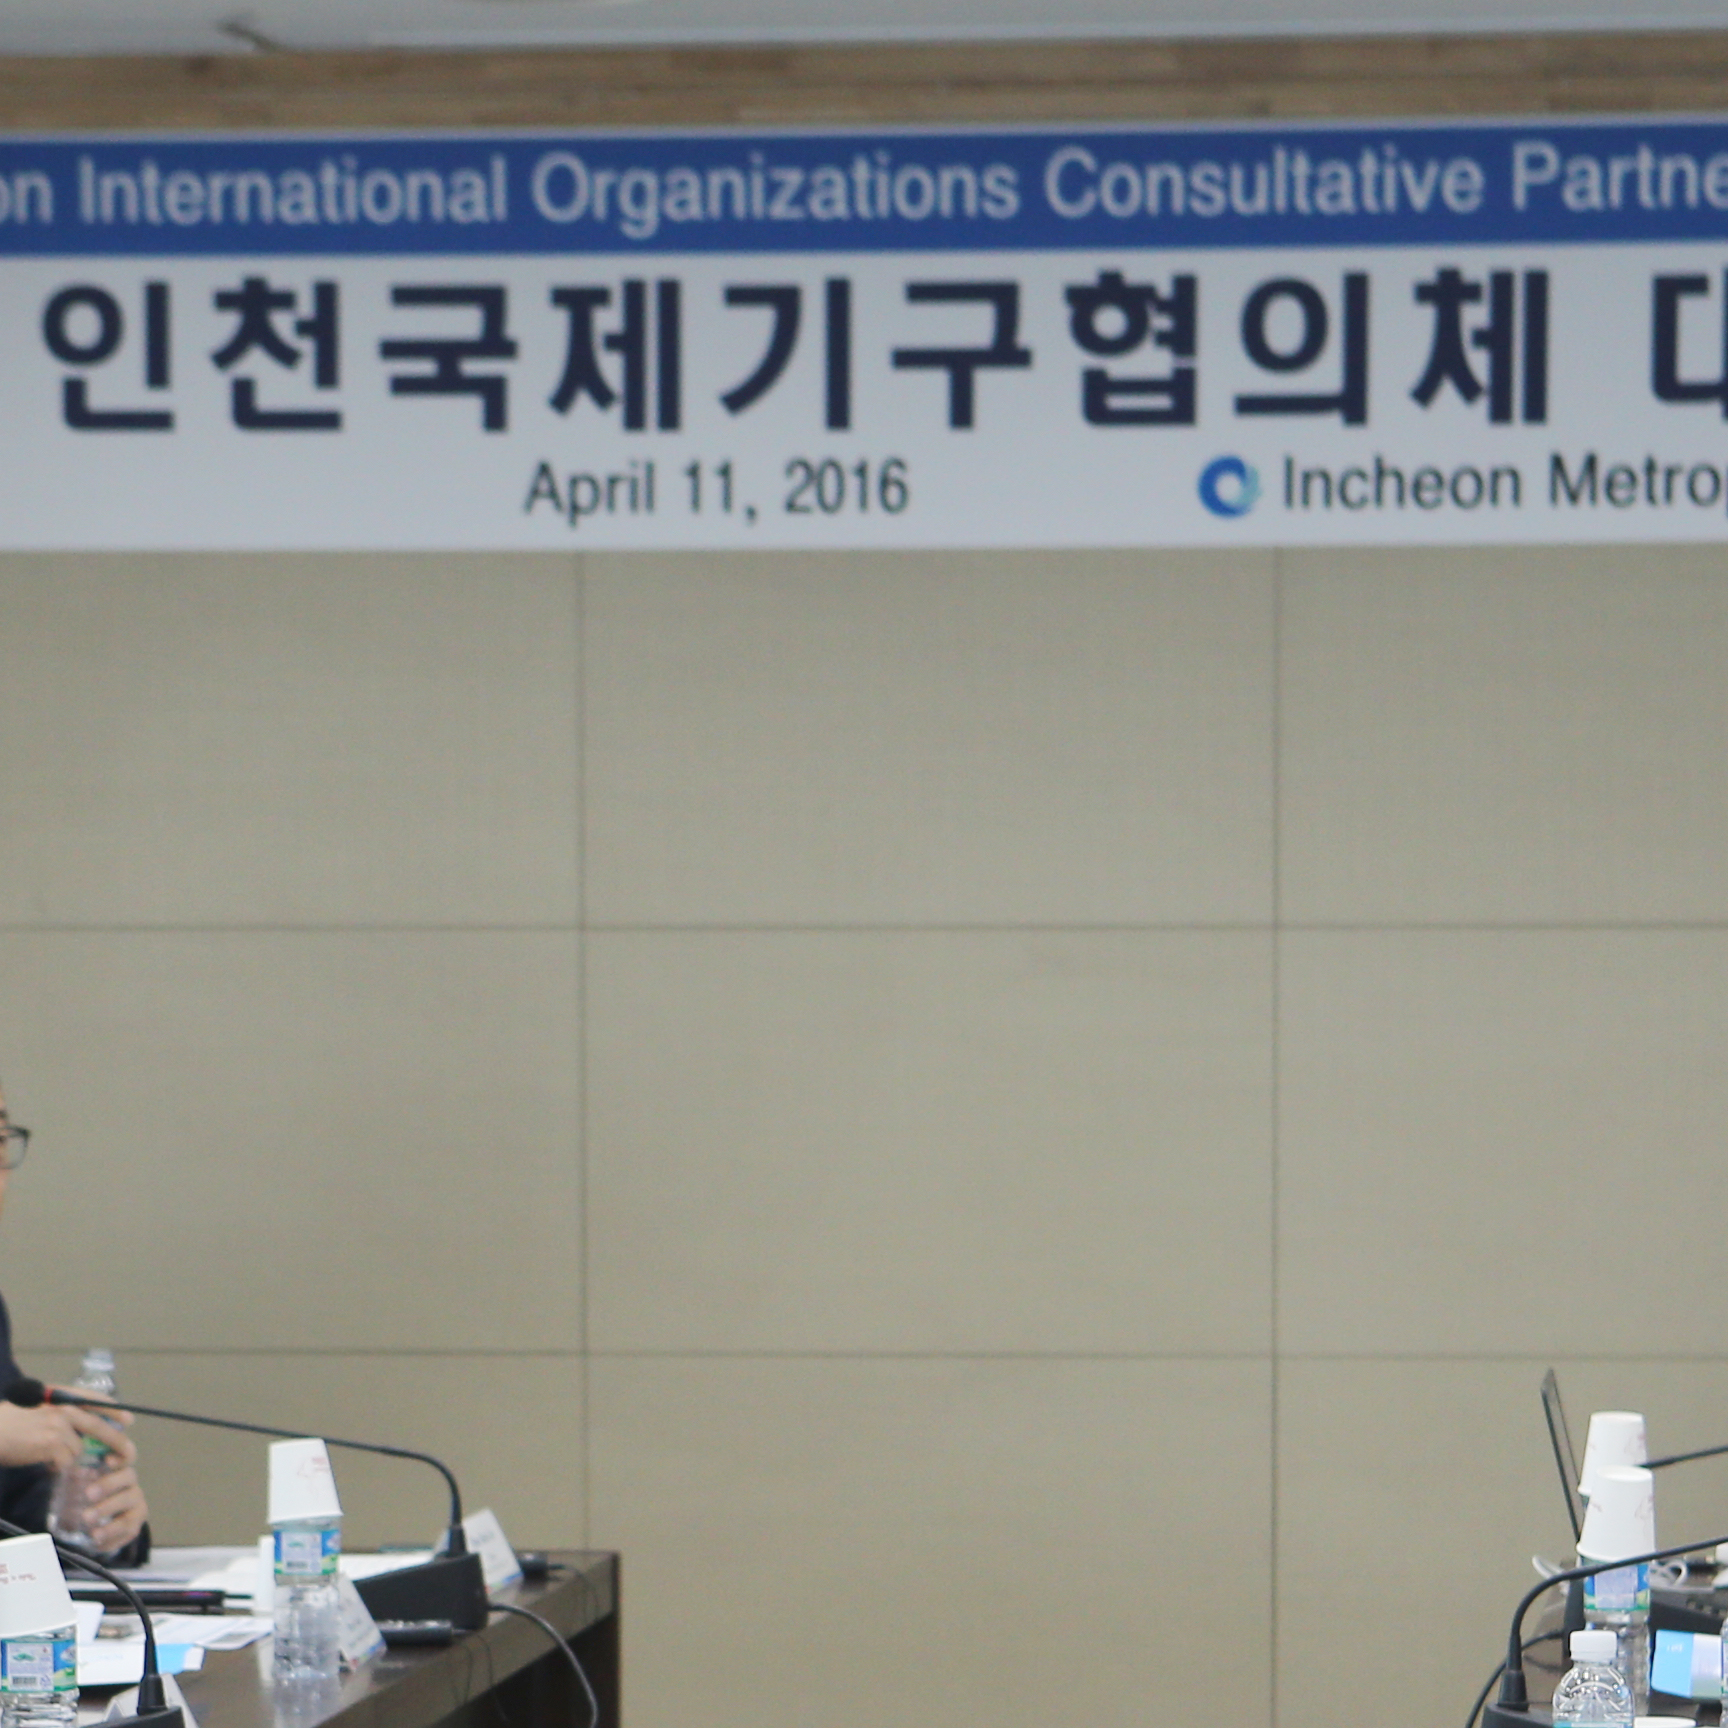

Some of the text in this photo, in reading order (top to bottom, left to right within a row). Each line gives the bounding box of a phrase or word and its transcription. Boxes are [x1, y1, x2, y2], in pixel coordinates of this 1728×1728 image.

[77, 160, 506, 225] International
[531, 154, 1021, 238] Organizations
[1044, 147, 1484, 217] Consultative
[38, 263, 1552, 435] 인천국제기구협의체
[521, 455, 912, 532] April 11, 2016
[1280, 450, 1524, 513] Incheon
